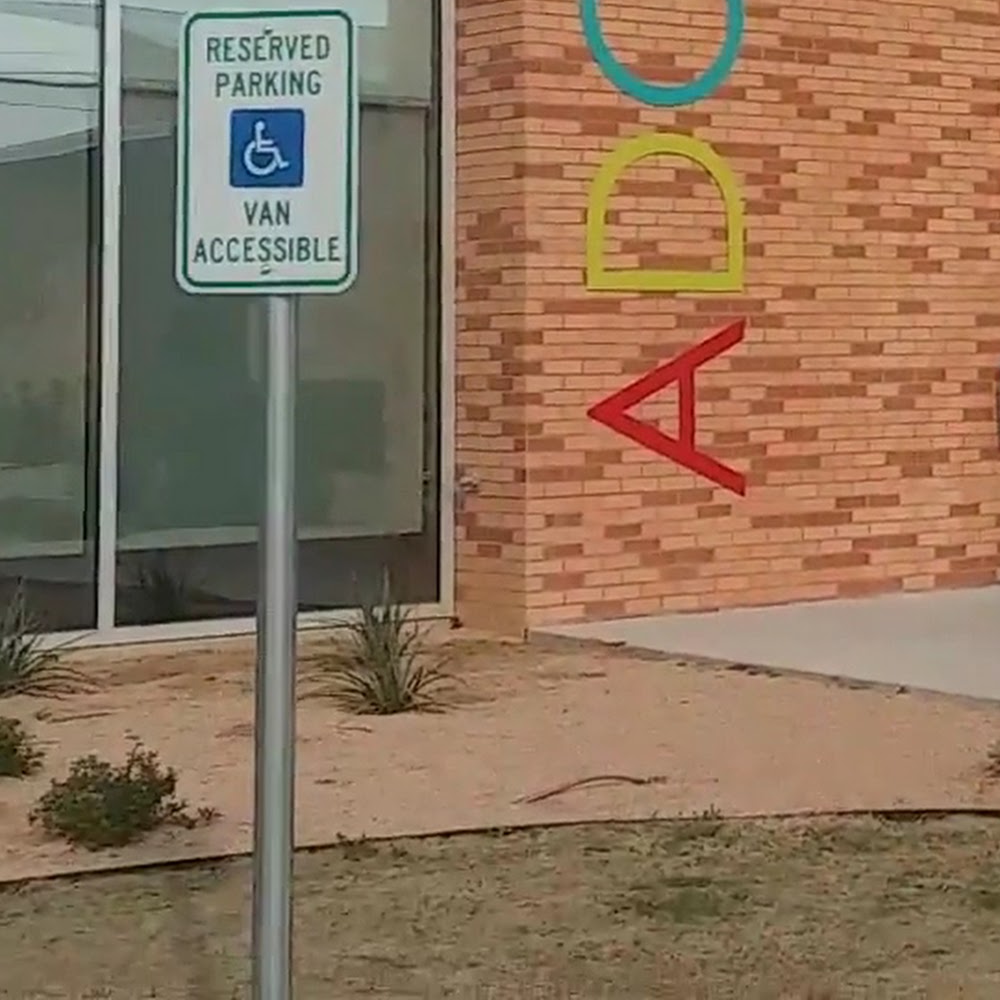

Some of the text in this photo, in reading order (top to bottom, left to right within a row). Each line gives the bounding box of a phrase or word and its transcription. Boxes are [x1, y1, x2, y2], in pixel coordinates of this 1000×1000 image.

[205, 34, 332, 64] RESERVED
[214, 70, 323, 98] PARKING
[243, 200, 292, 227] VAN
[191, 235, 342, 264] ACCESSIBLE
